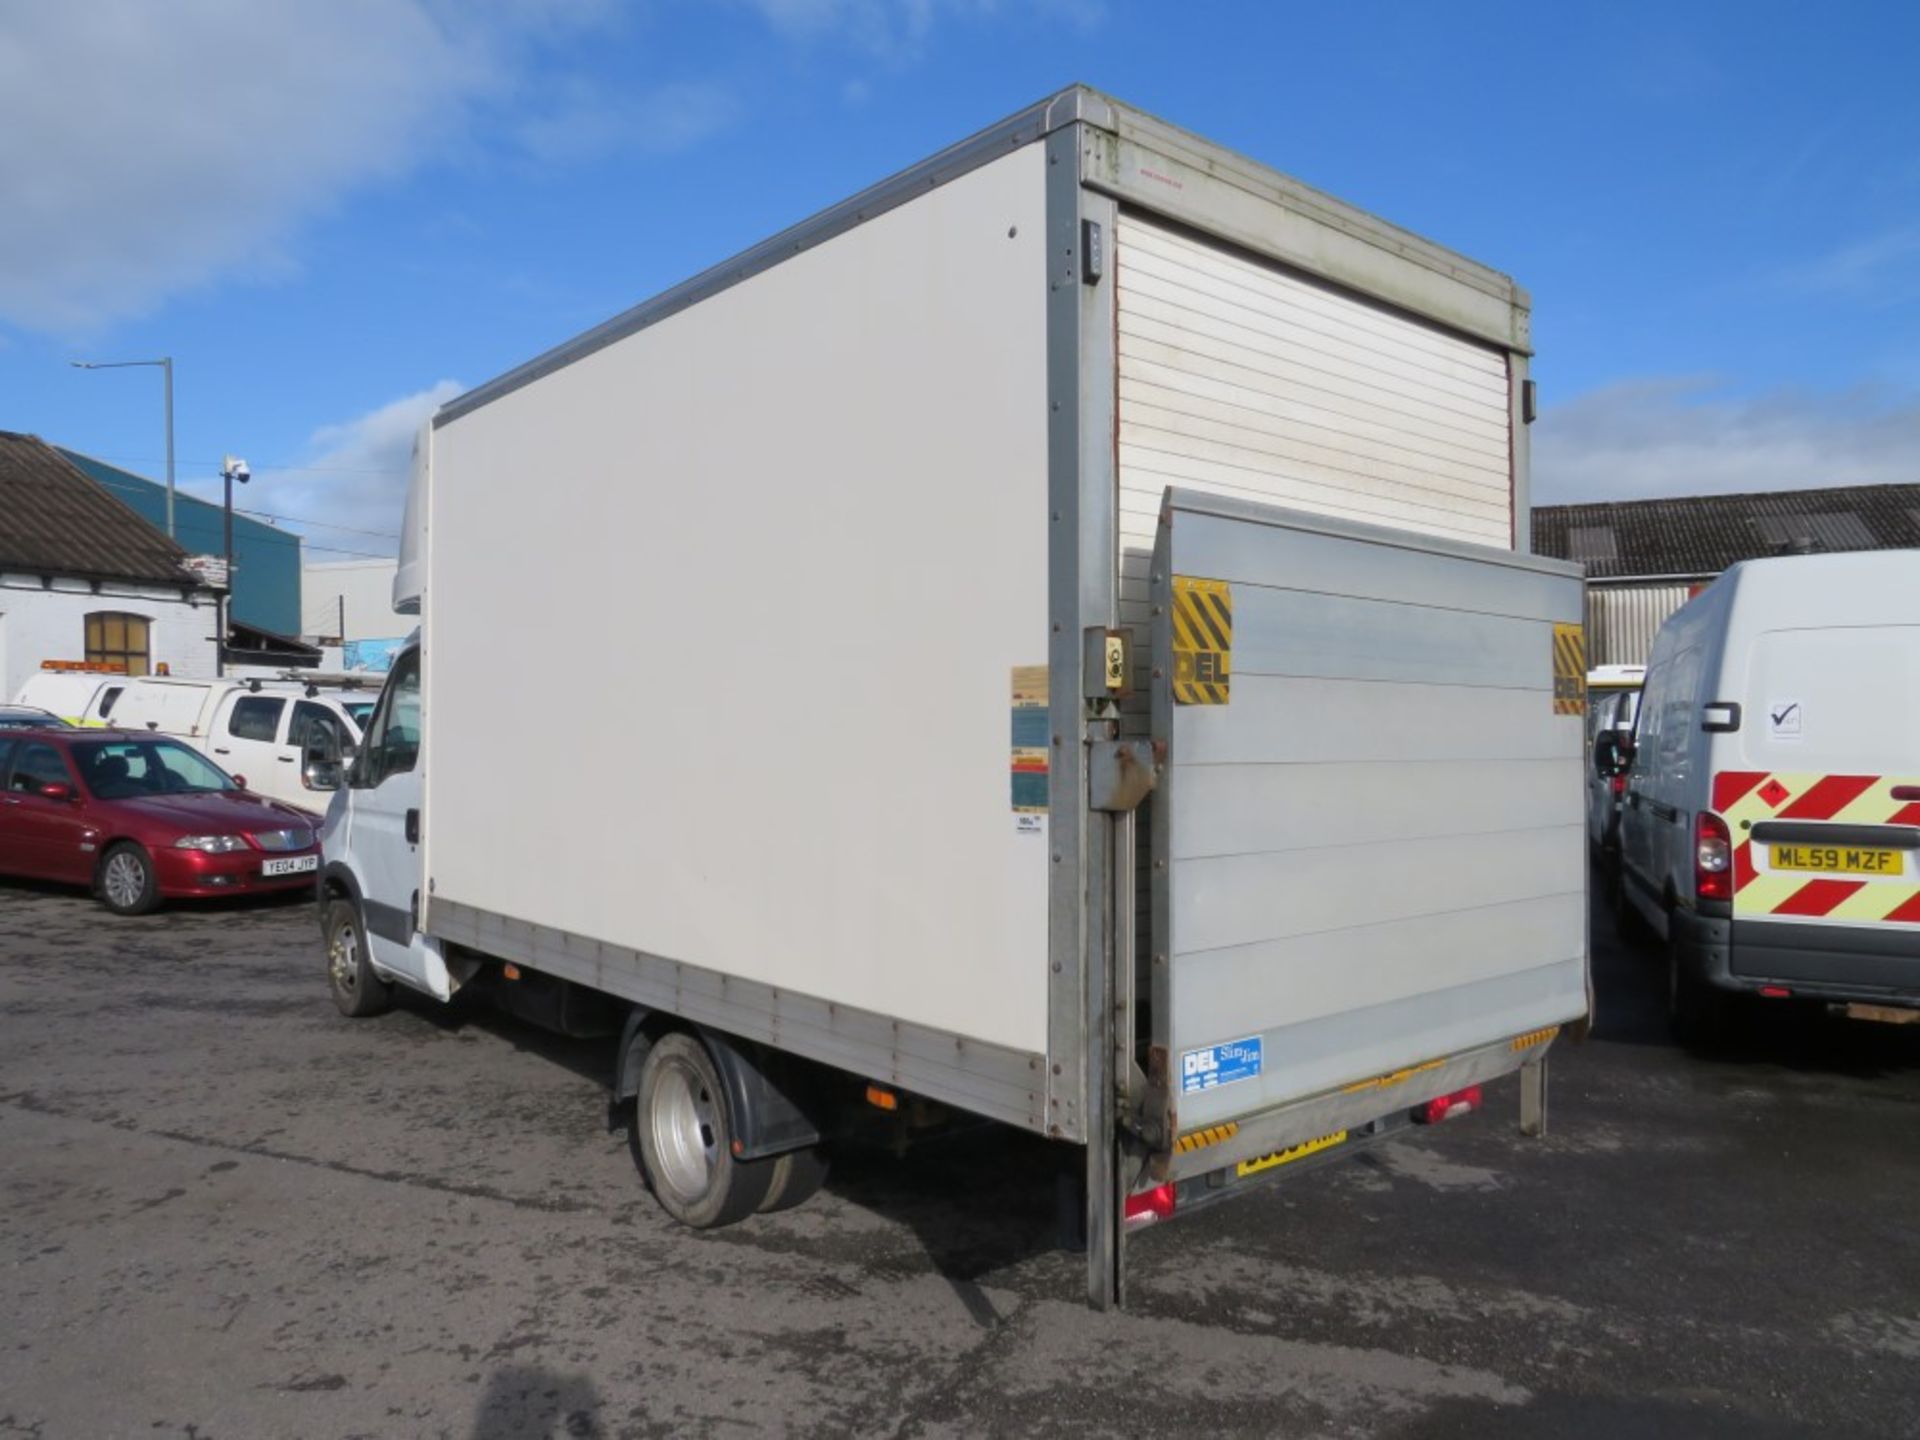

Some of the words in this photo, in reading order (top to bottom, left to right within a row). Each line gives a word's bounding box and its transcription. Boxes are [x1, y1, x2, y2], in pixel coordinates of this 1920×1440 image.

[1173, 651, 1229, 683] DEL
[267, 859, 295, 874] YE04
[1777, 848, 1839, 868] ML59
[1845, 850, 1893, 870] MZF
[1184, 1049, 1219, 1076] DEL
